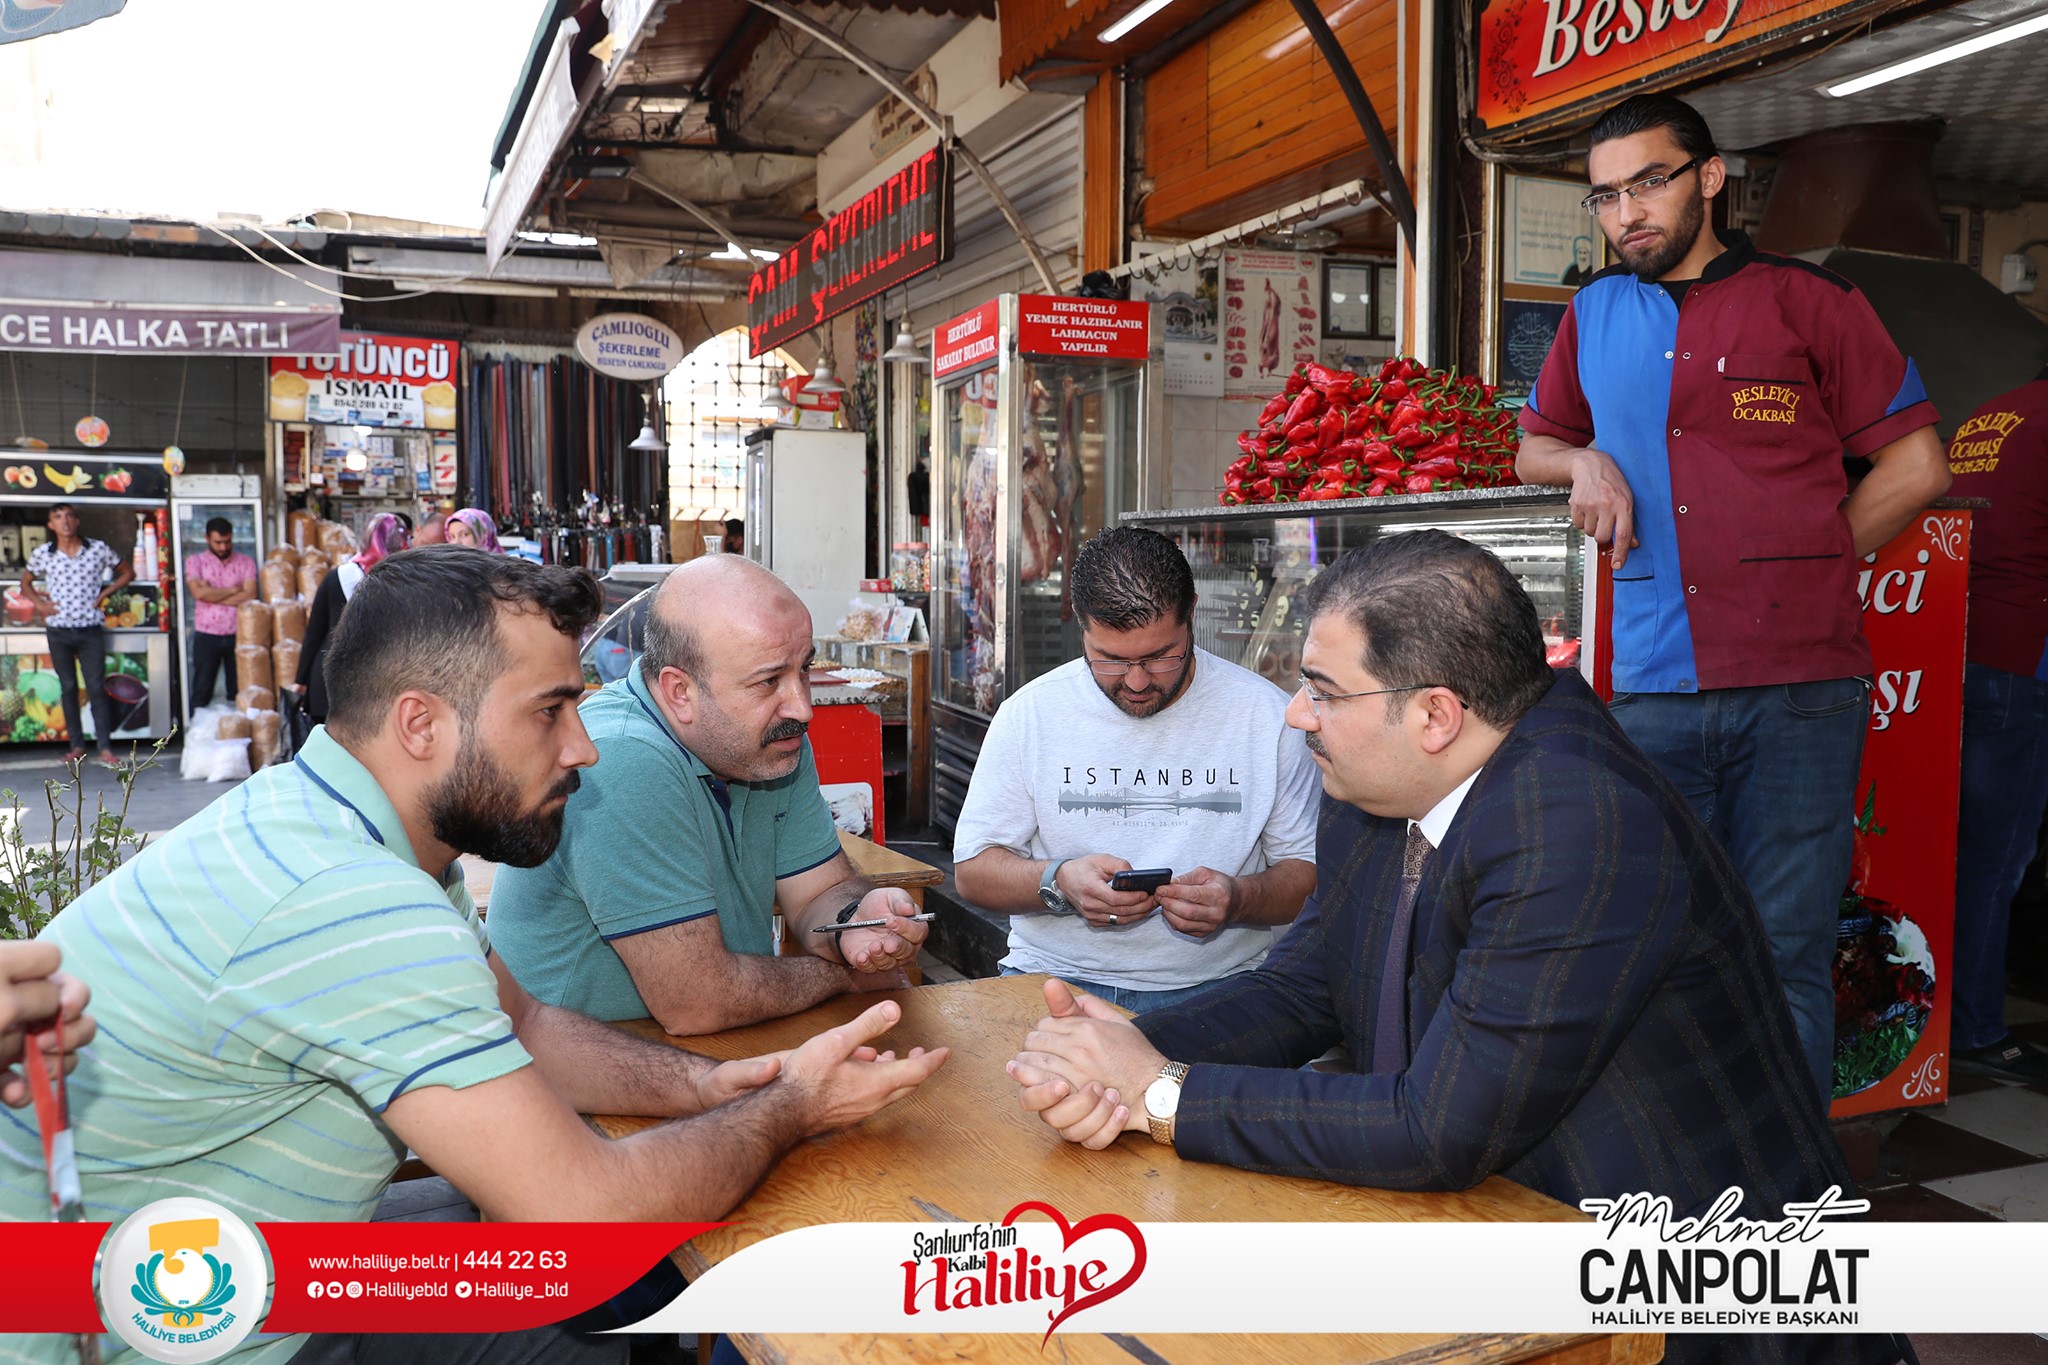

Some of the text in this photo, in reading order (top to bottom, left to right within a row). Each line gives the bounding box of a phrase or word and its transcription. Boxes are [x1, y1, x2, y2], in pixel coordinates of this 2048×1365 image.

[1052, 302, 1118, 315] HERTÜRLÜ
[1025, 313, 1143, 329] YEMEK HAZIRLANIR
[63, 316, 190, 348] HALKA
[196, 320, 289, 349] TATLI
[1051, 328, 1118, 341] LAHMACUN
[598, 341, 661, 358] ŞEKERLEME
[1060, 342, 1108, 353] YAPILIR
[325, 373, 414, 401] İSMAİL
[1731, 386, 1800, 410] BESLEYİCİ
[1733, 407, 1796, 425] OCAKBAŞI
[1063, 767, 1240, 786] ISTANBUL
